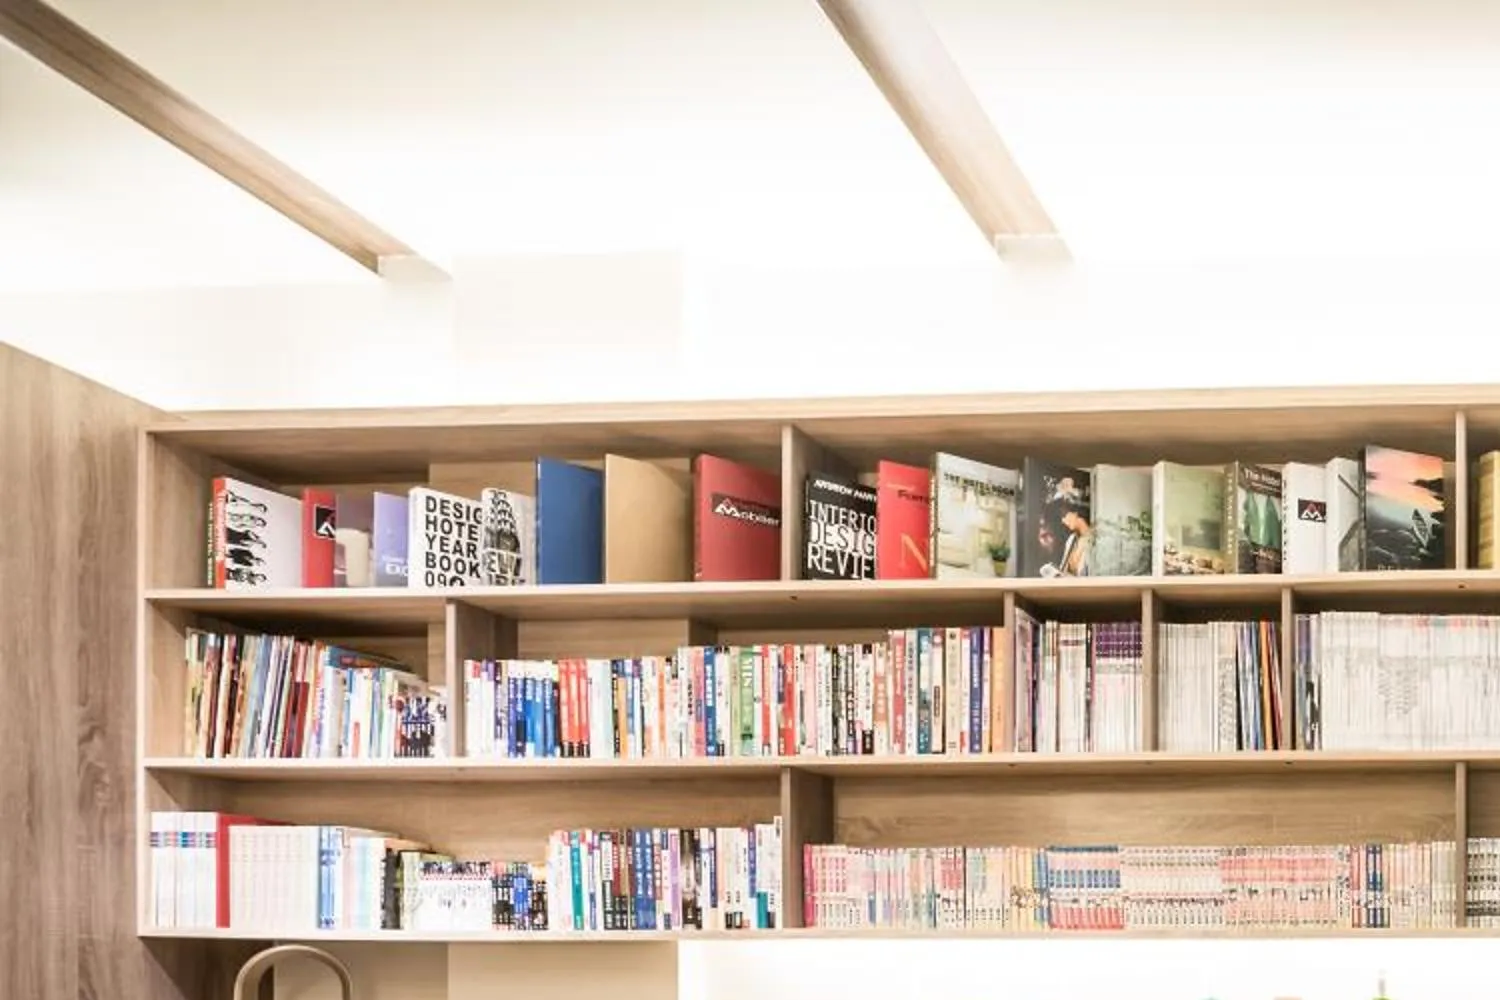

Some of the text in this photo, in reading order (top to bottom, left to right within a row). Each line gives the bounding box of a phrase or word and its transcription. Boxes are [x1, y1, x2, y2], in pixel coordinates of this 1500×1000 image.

[425, 495, 482, 525] DESIG
[809, 499, 877, 534] INTERIO
[425, 514, 479, 542] HOTE
[809, 520, 877, 556] DESIG
[425, 532, 478, 560] YEAR
[807, 542, 874, 580] REVIE
[425, 551, 481, 579] BOOK
